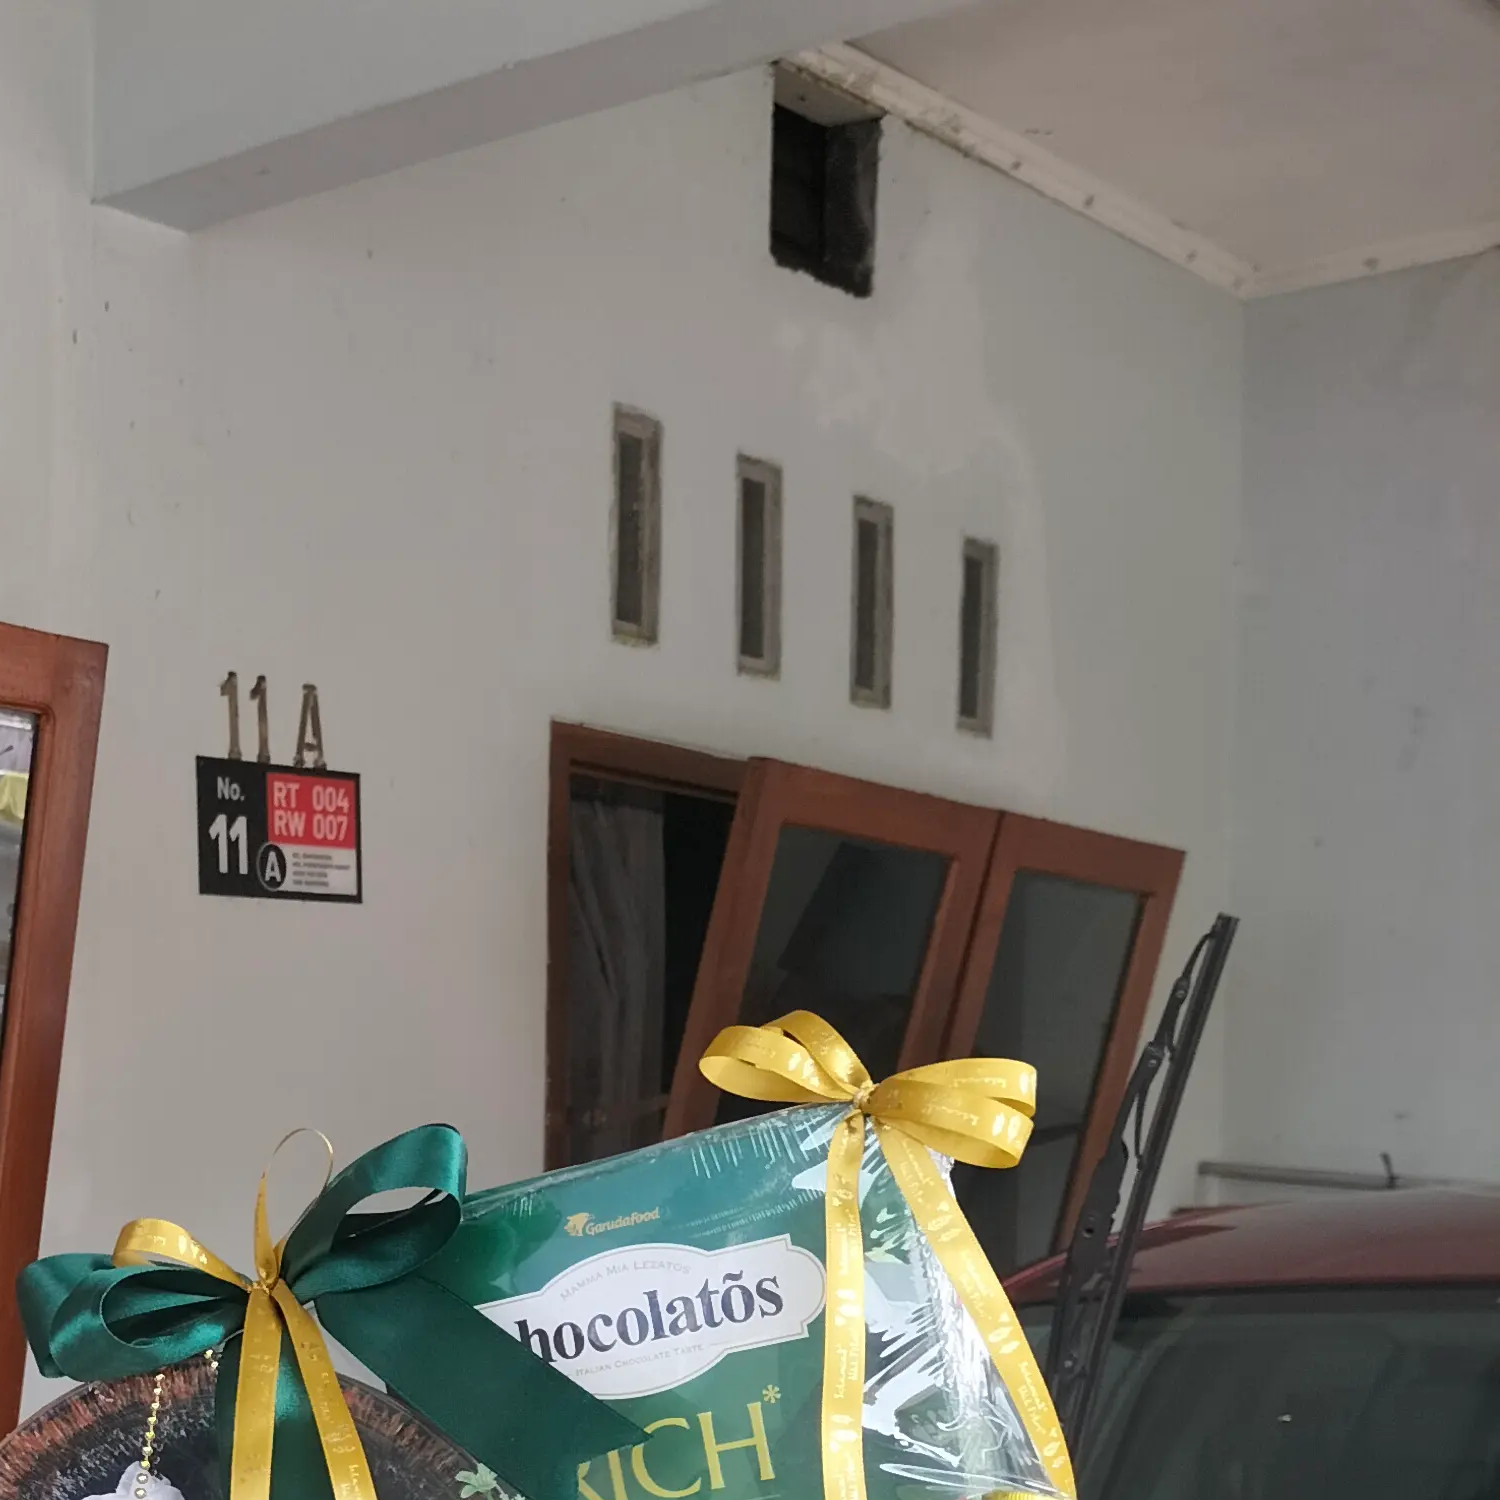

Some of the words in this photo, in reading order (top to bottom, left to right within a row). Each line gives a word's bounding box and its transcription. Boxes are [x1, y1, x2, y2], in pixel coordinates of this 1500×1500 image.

[219, 671, 270, 765] 11
[293, 683, 328, 772] A
[217, 776, 245, 801] No.
[273, 781, 299, 808] RT
[312, 786, 350, 814] 004
[273, 810, 307, 838] RW
[313, 814, 348, 841] 007
[208, 814, 249, 876] 11
[264, 850, 282, 883] A
[585, 1207, 661, 1236] Garudafood
[514, 1269, 784, 1363] hocolatõs
